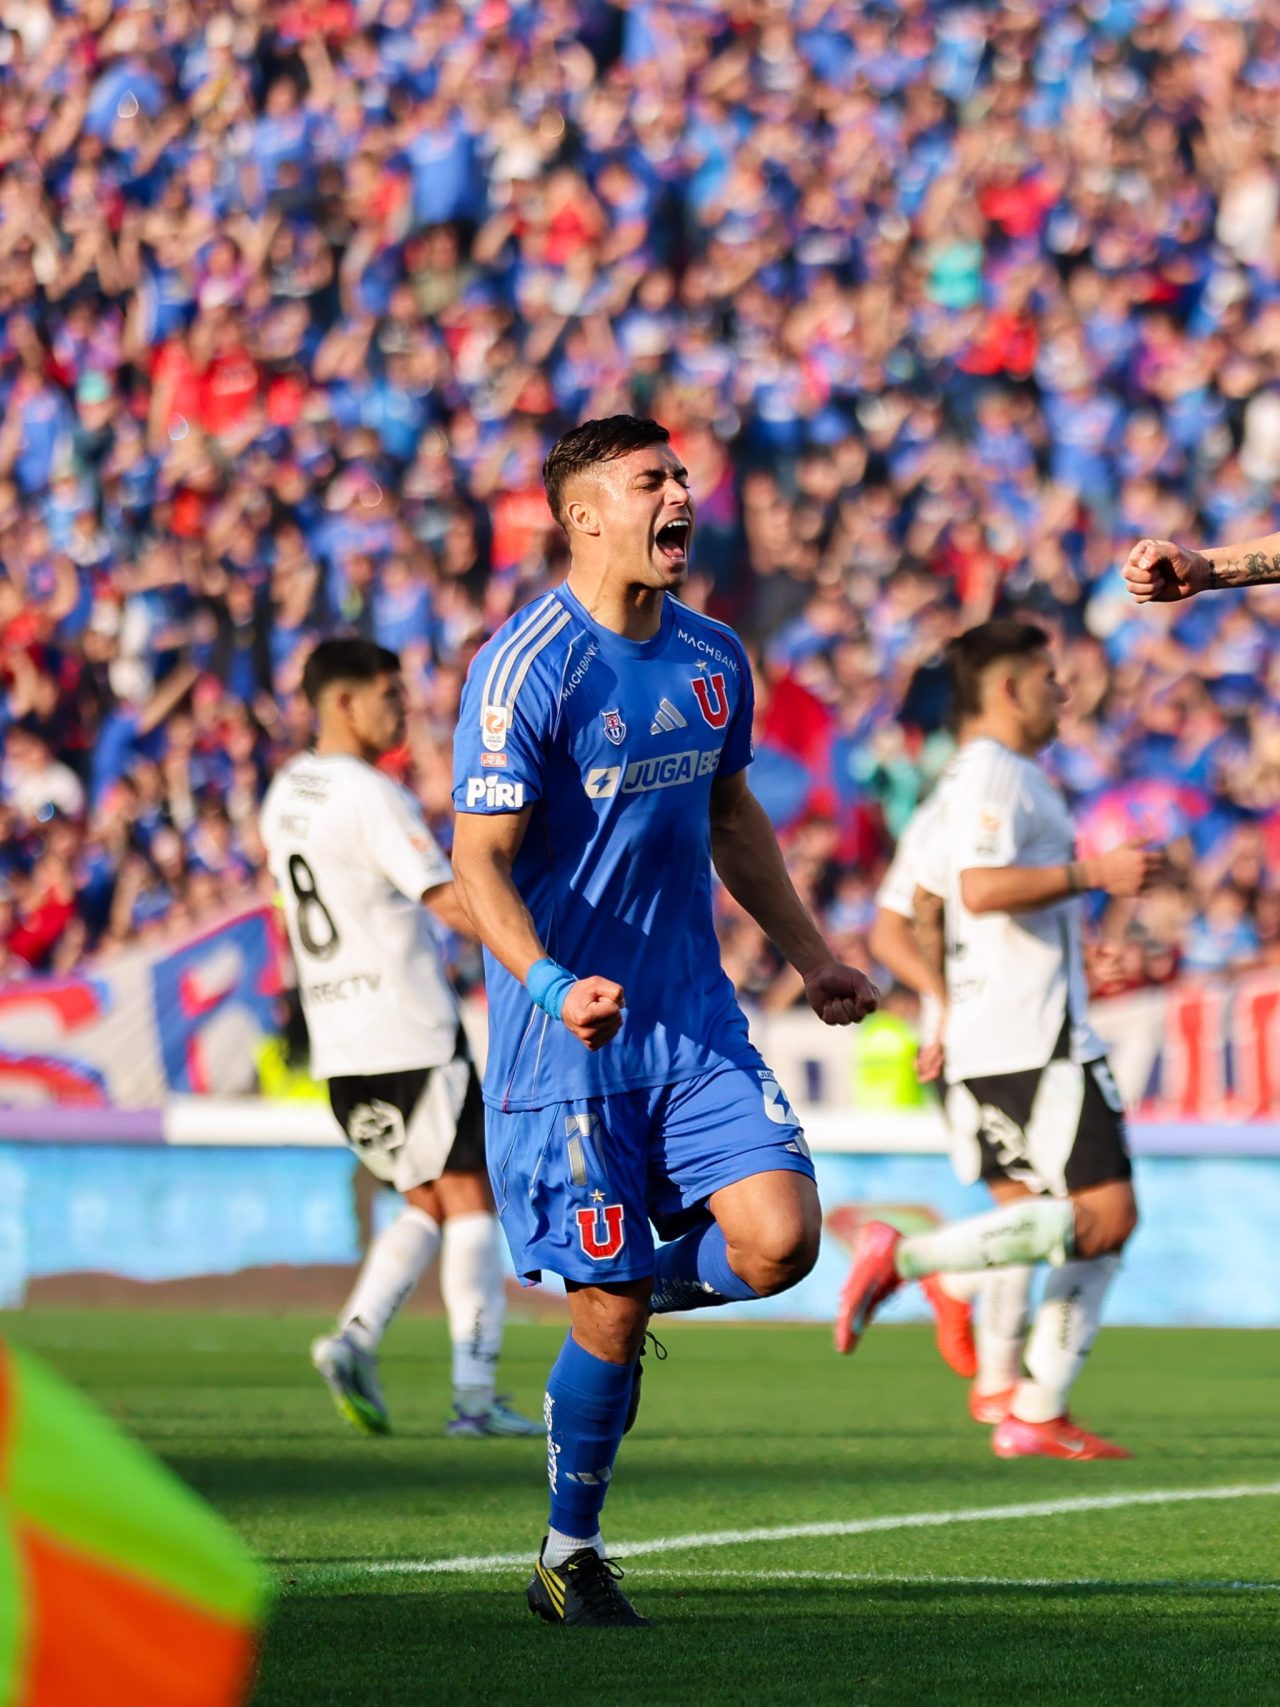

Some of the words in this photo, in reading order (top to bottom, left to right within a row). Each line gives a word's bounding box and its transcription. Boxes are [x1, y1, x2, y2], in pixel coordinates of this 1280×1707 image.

[691, 672, 730, 730] U
[289, 854, 339, 960] 8
[576, 1204, 625, 1261] U
